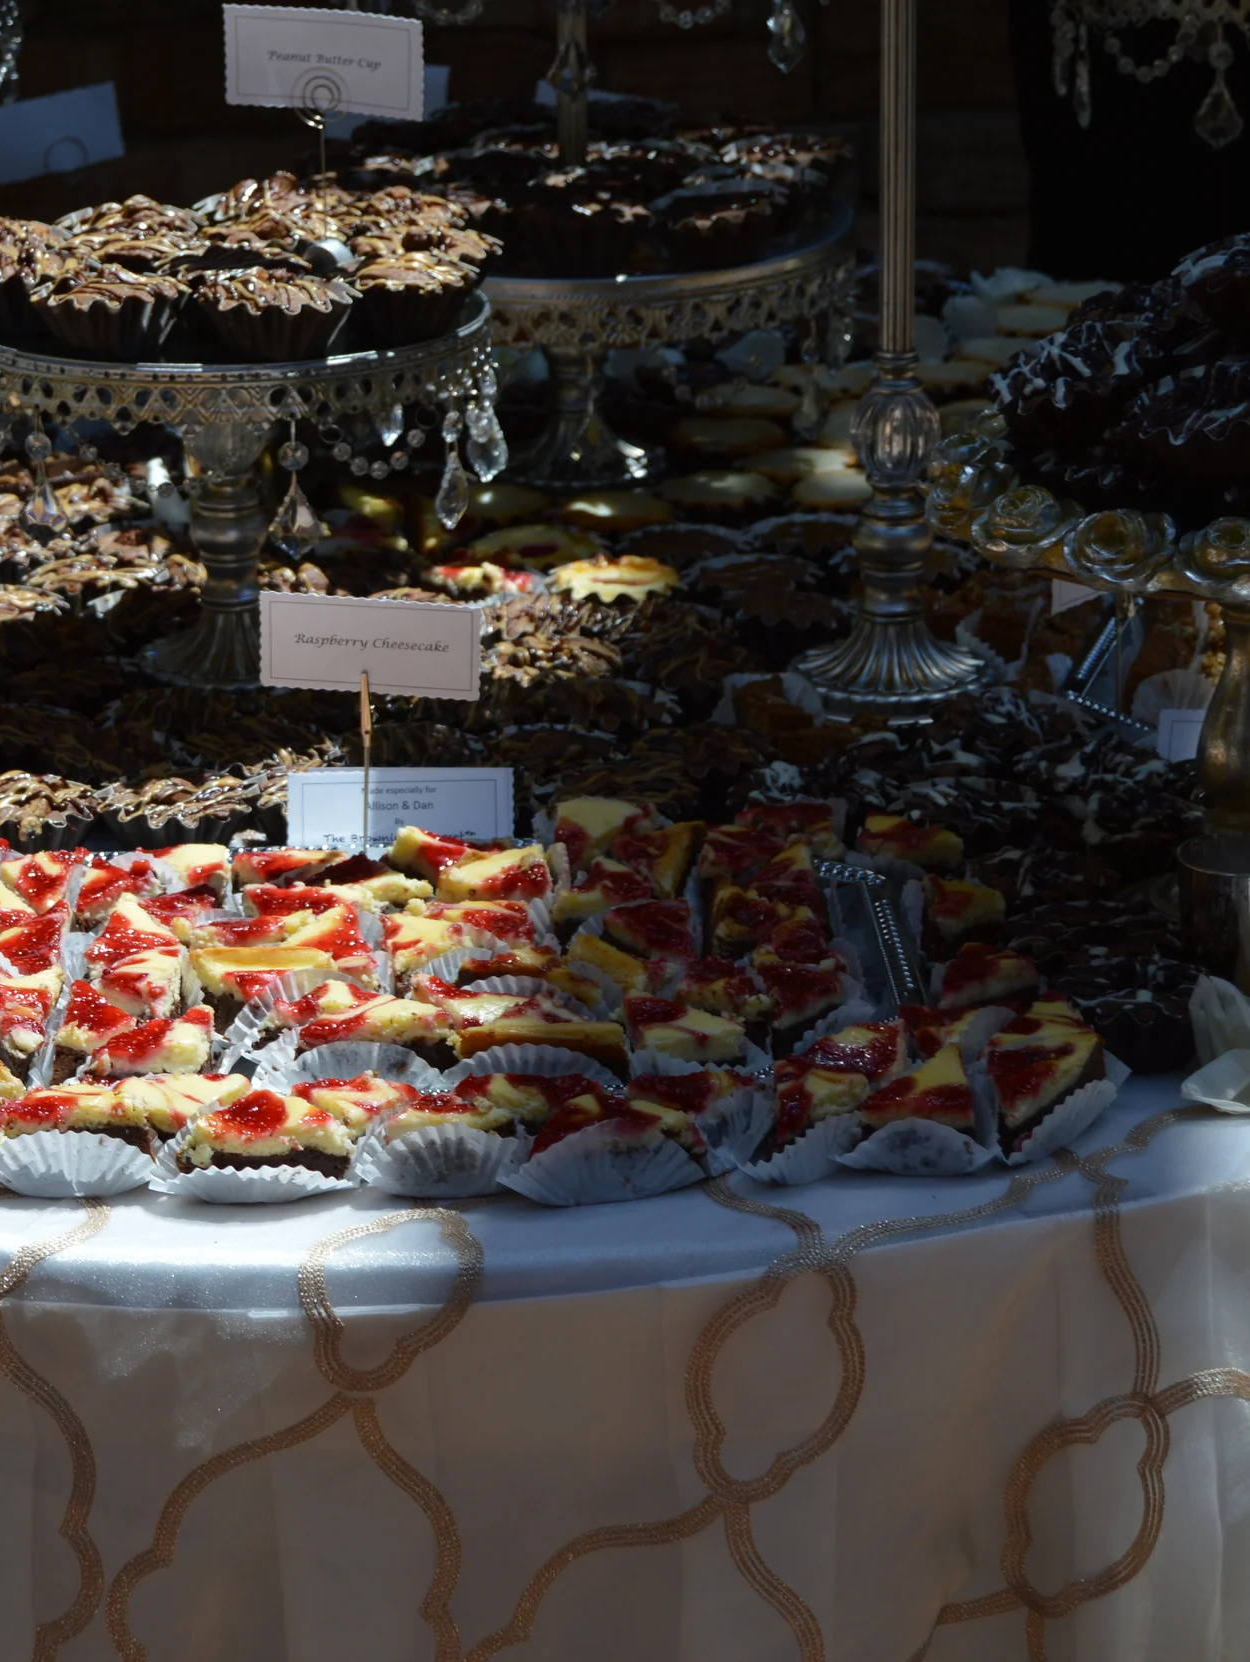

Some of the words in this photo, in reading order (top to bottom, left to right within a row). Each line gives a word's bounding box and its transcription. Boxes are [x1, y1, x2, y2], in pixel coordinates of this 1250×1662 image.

[268, 50, 311, 63] Peanut
[315, 53, 355, 66] Butter
[357, 57, 382, 73] Cup
[294, 632, 369, 651] Raspberry
[372, 637, 450, 653] Cheesecake
[386, 785, 424, 796] especially
[425, 785, 437, 794] for
[402, 801, 410, 810] &
[413, 800, 434, 810] Dan
[394, 817, 405, 826] By
[323, 834, 346, 843] The
[351, 833, 399, 843] Browni
